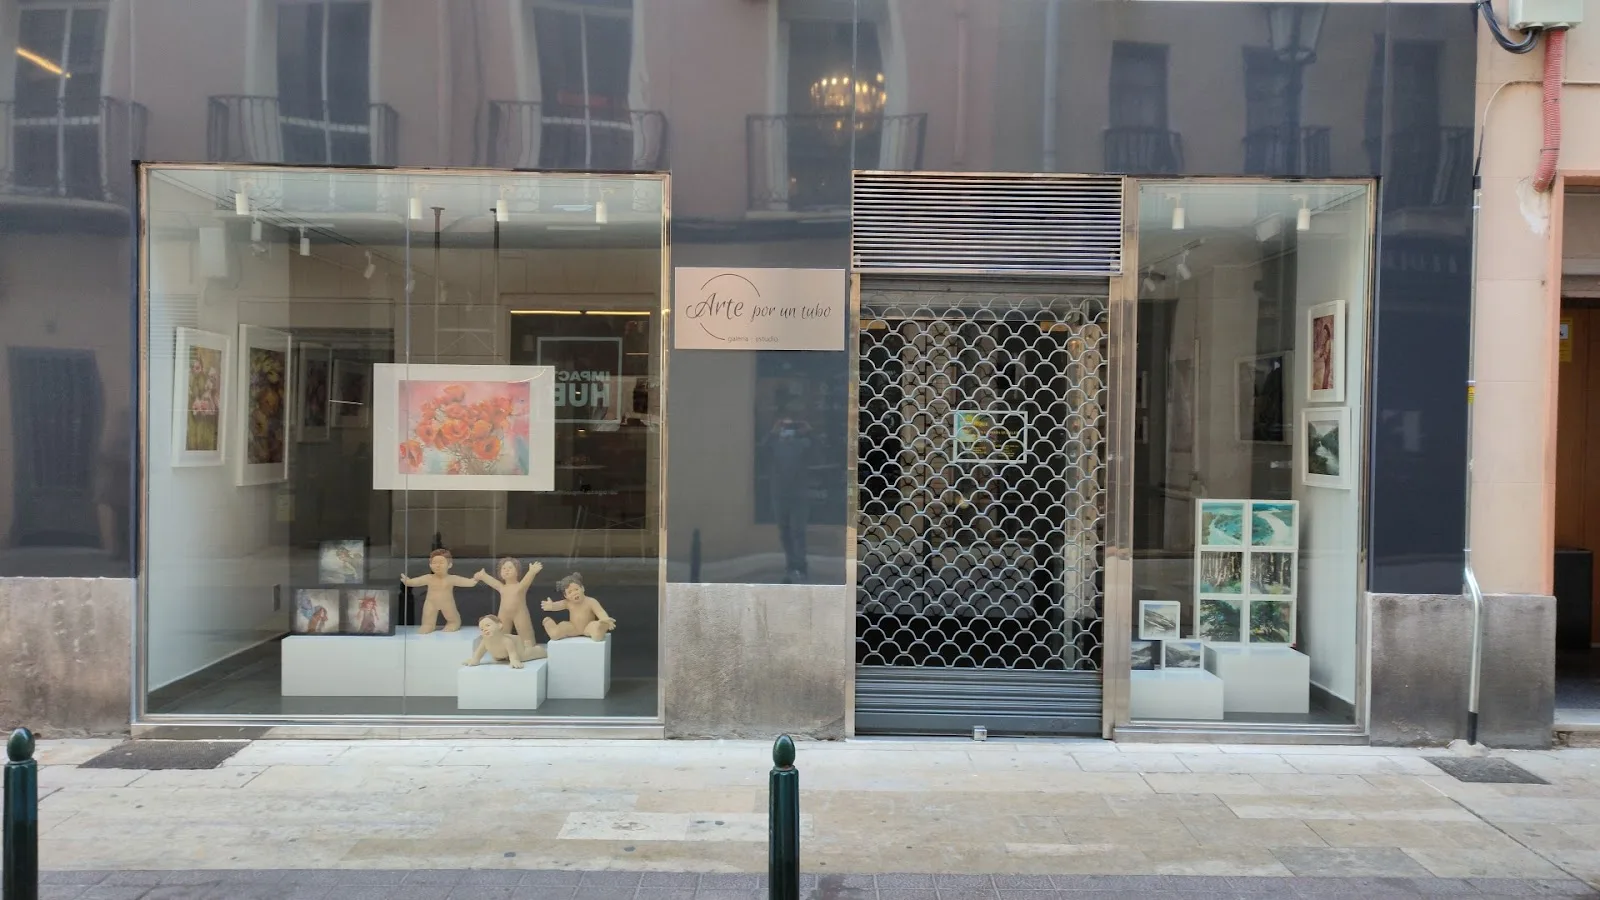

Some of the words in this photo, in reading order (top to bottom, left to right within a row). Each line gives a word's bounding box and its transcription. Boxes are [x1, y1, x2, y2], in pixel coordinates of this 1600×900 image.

[685, 292, 744, 320] Arte
[750, 305, 776, 322] por
[779, 308, 796, 319] un
[800, 303, 832, 320] tubo
